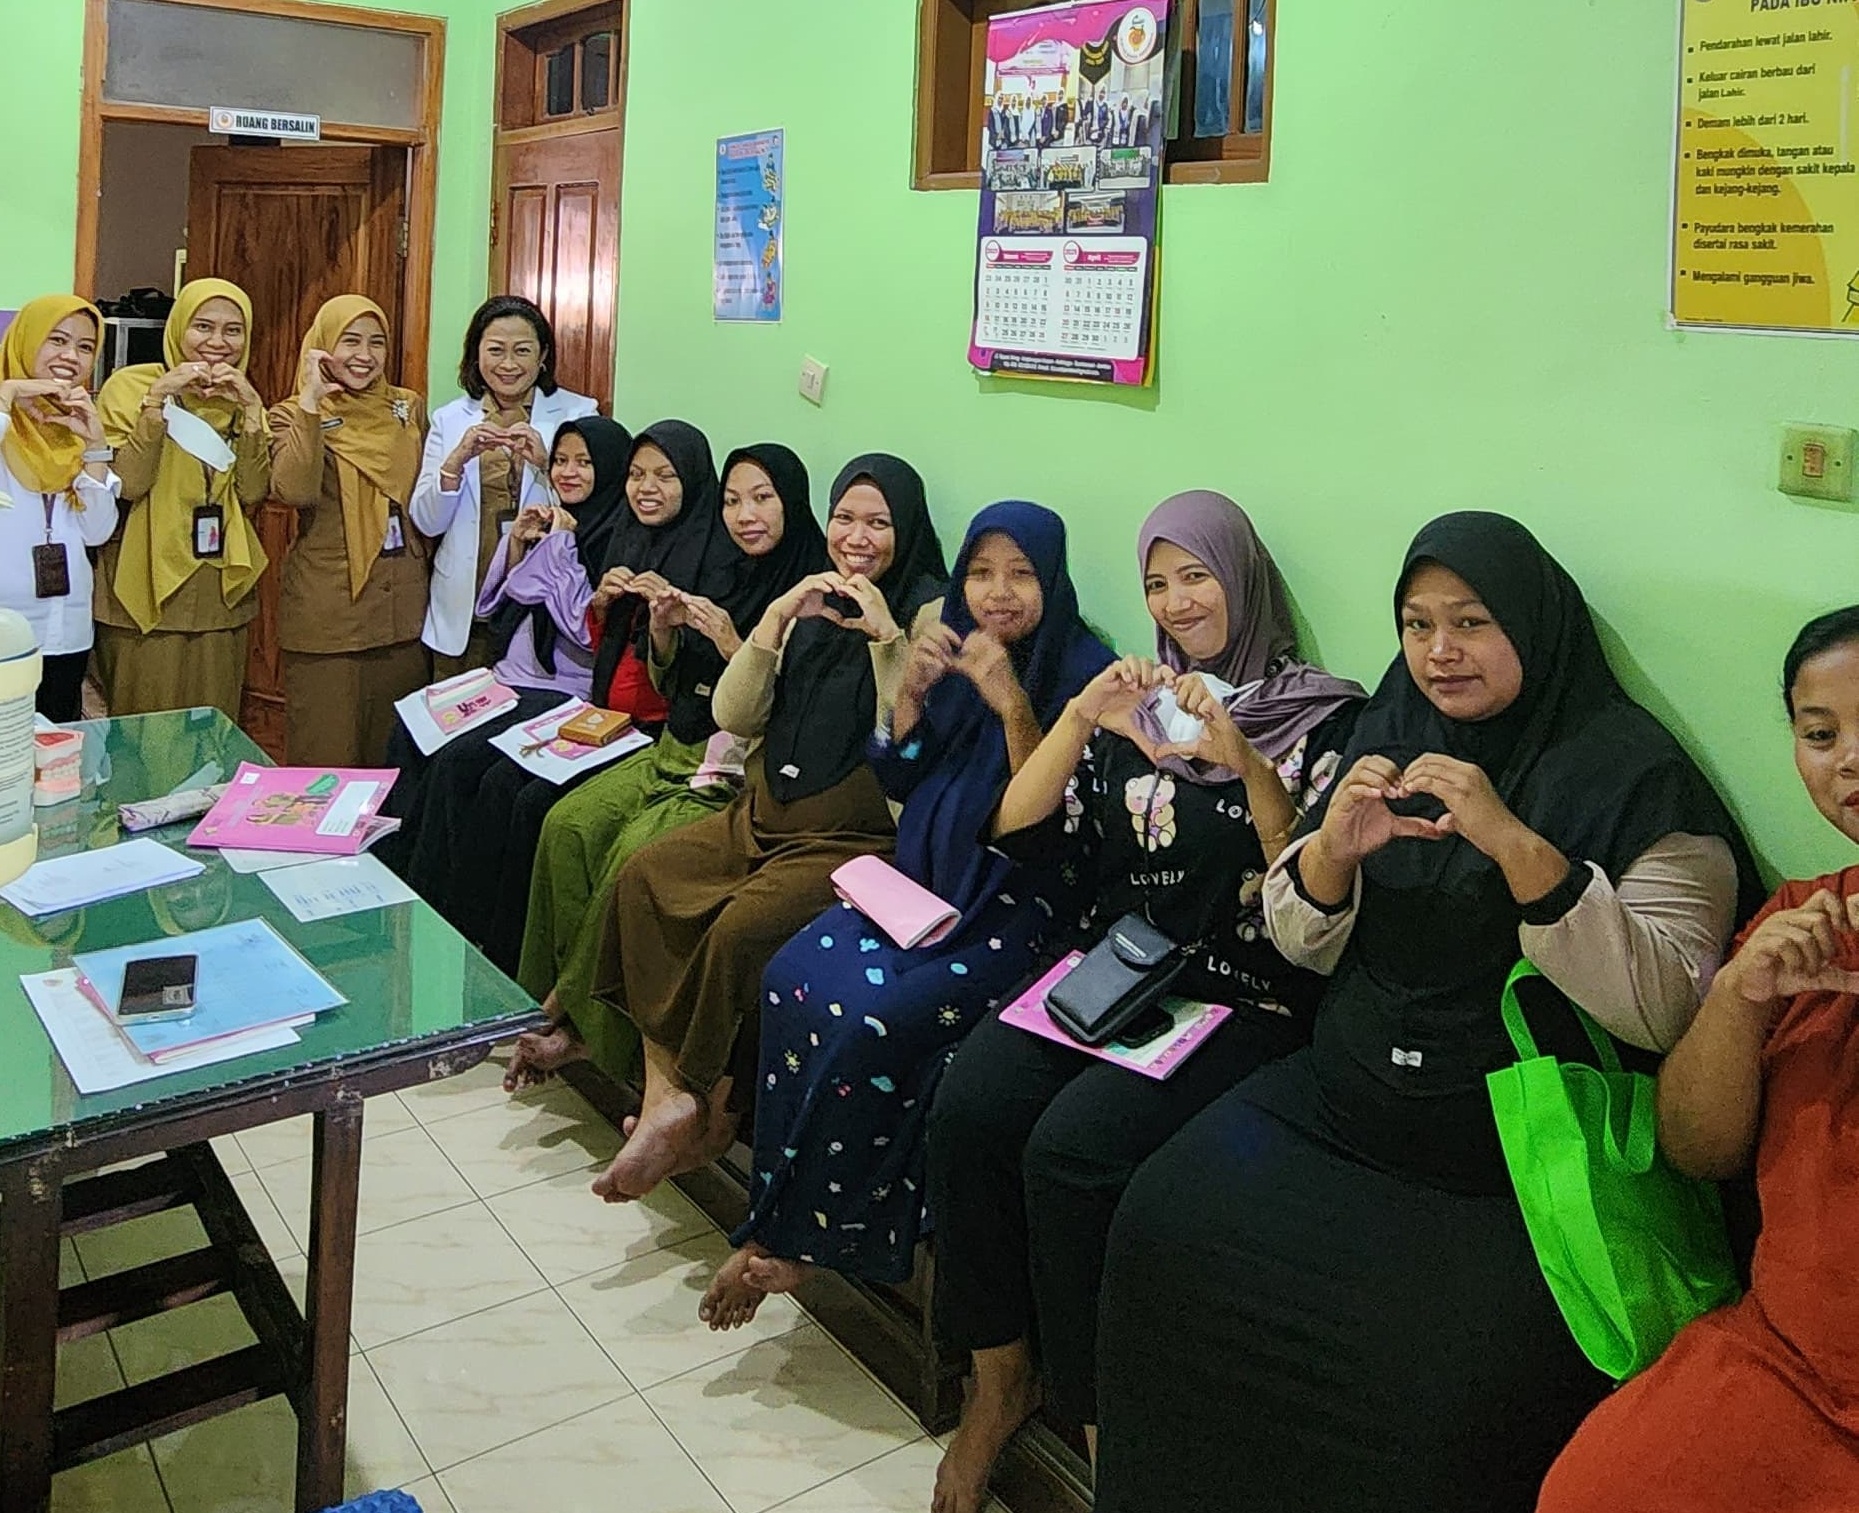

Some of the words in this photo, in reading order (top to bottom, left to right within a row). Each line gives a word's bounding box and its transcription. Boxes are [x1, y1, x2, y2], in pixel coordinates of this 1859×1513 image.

[1755, 34, 1780, 46] lewat
[1782, 33, 1805, 47] jalan
[1808, 29, 1832, 41] lahir.
[1699, 71, 1727, 82] Keluar
[1730, 69, 1758, 80] cairan
[1761, 67, 1793, 78] berbau
[1796, 63, 1816, 75] dari
[1698, 88, 1719, 102] jalan
[236, 115, 268, 130] RUANG
[271, 118, 315, 133] BERSALIN
[1698, 118, 1730, 128] Demam
[1733, 115, 1755, 127] lebih
[1758, 114, 1776, 125] dari
[1779, 114, 1785, 124] 2
[1787, 112, 1809, 123] hari.
[1697, 148, 1734, 161] Bengkak
[1777, 147, 1810, 159] tangan
[1812, 145, 1834, 155] atau
[1696, 166, 1714, 177] kaki
[1716, 165, 1755, 178] mungkin
[1758, 165, 1793, 178] dengan
[1796, 163, 1820, 175] sakit
[1822, 162, 1855, 176] kepala
[1696, 184, 1711, 194] dan
[1694, 222, 1735, 235] Payudara
[1738, 222, 1777, 235] bengkak
[1780, 223, 1834, 233] kemerahan
[1693, 239, 1727, 249] disertai
[1728, 241, 1748, 249] rasa
[1692, 271, 1740, 284] Mengalami
[1743, 274, 1790, 286] gangguan
[1130, 870, 1185, 886] LOVELY
